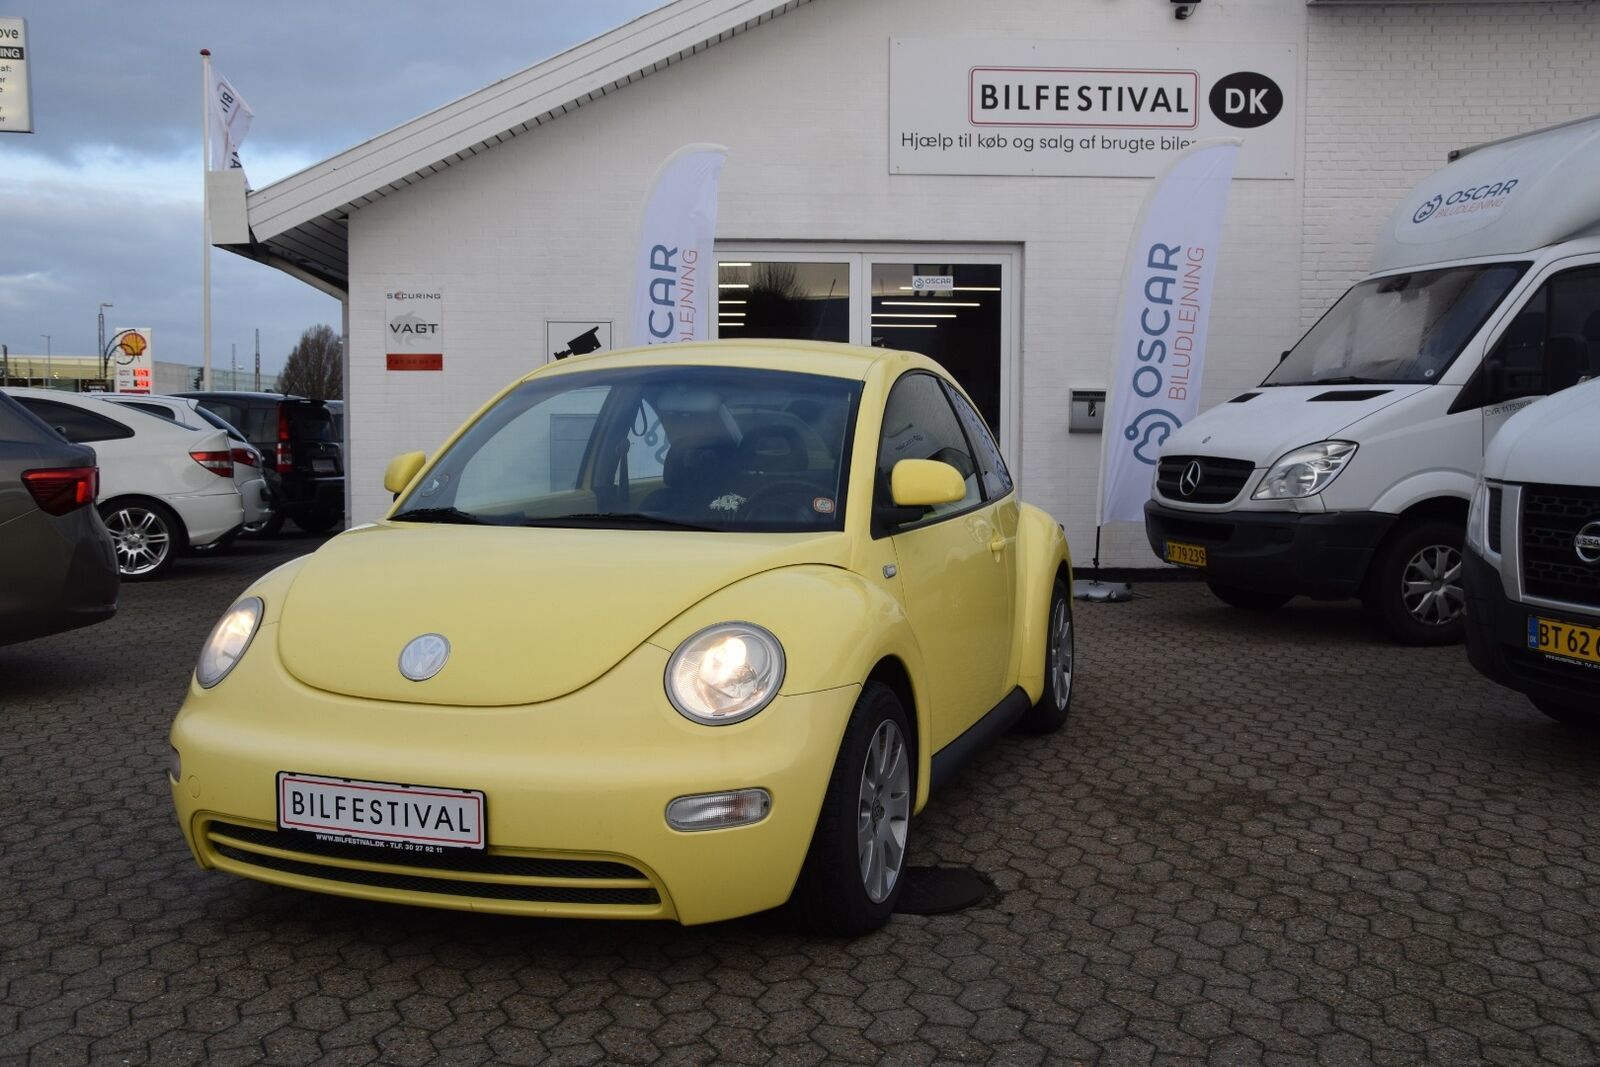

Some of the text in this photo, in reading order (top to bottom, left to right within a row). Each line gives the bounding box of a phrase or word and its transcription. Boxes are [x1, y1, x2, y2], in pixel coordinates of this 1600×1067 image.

[981, 84, 1269, 115] BILFESTIVAL DK
[901, 132, 953, 151] Hjælp
[958, 133, 972, 148] til
[978, 133, 1007, 149] køb
[1013, 137, 1034, 152] og
[1040, 134, 1074, 153] salg
[1079, 134, 1096, 150] af
[1101, 136, 1155, 154] brugte
[1445, 179, 1519, 206] OSCAR
[386, 291, 441, 300] SECURING
[390, 323, 439, 334] VAGT
[1132, 243, 1181, 398] OSCAR
[1168, 247, 1205, 400] BILUDLEJNING
[1540, 624, 1562, 648] BT
[1567, 629, 1590, 655] 62
[292, 790, 471, 833] BILFESTIVAL
